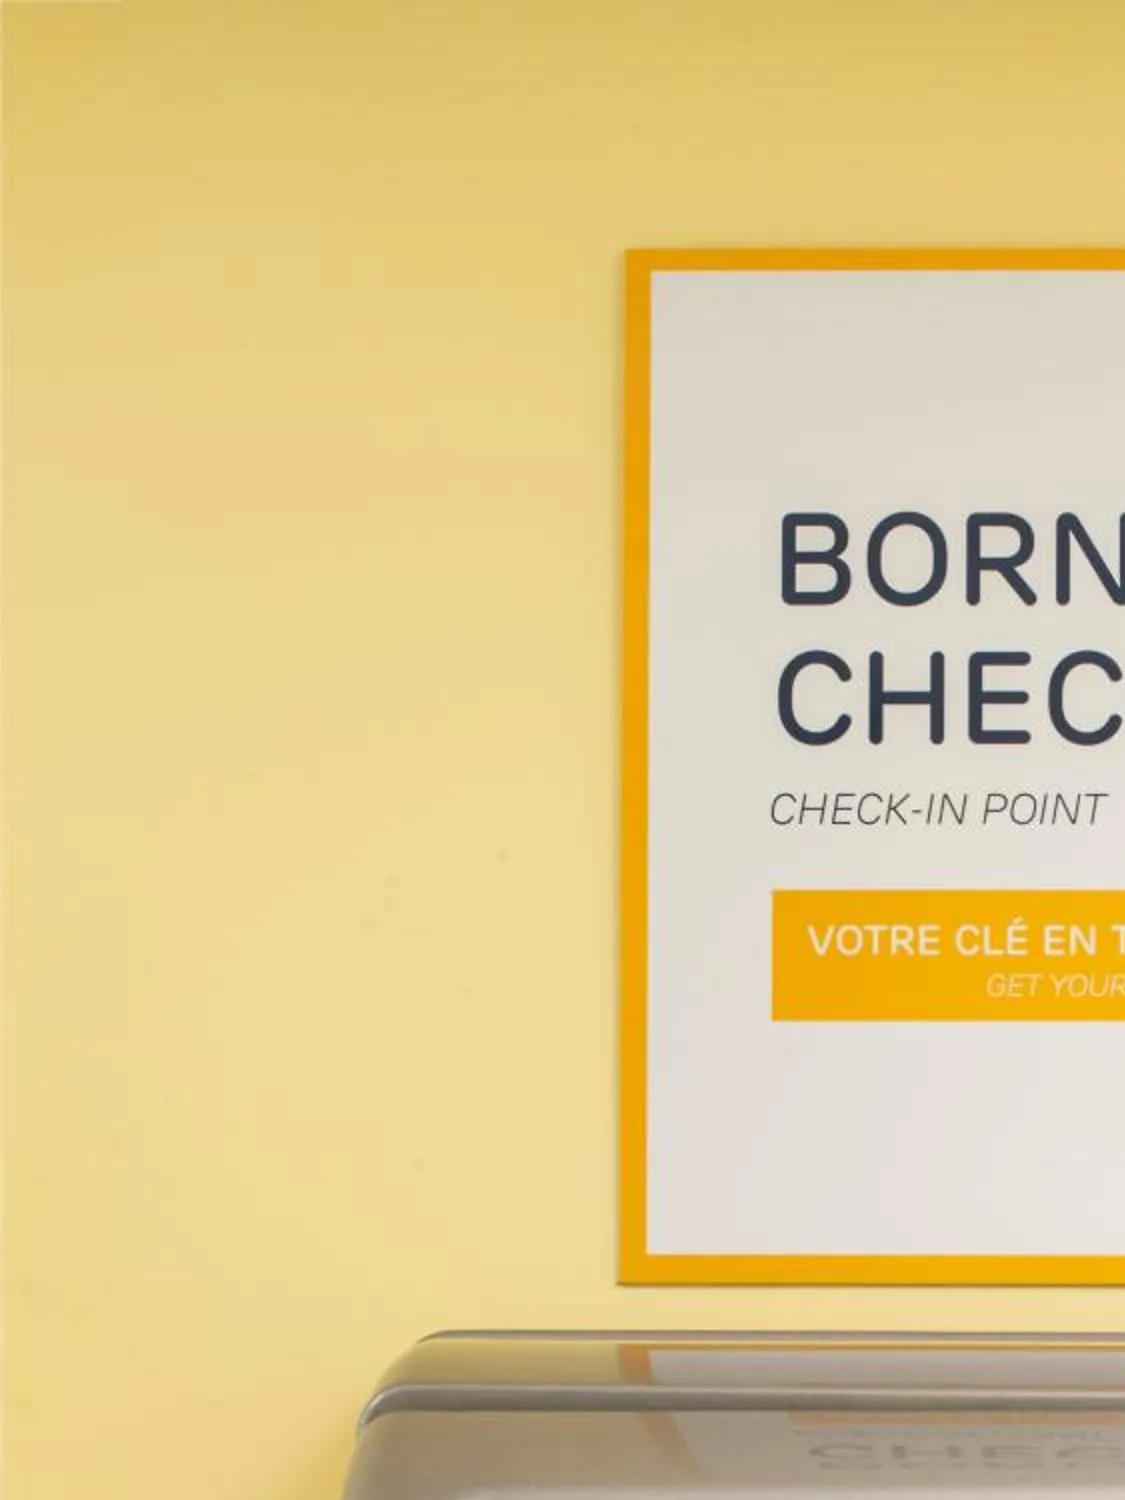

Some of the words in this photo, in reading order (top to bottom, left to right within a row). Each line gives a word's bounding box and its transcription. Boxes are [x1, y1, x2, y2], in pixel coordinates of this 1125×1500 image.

[770, 792, 967, 826] CHECK-IN
[983, 792, 1109, 826] POINT
[808, 923, 940, 957] VOTRE
[955, 917, 1028, 957] CLÉ
[1043, 923, 1097, 957] EN
[985, 972, 1044, 999] GET
